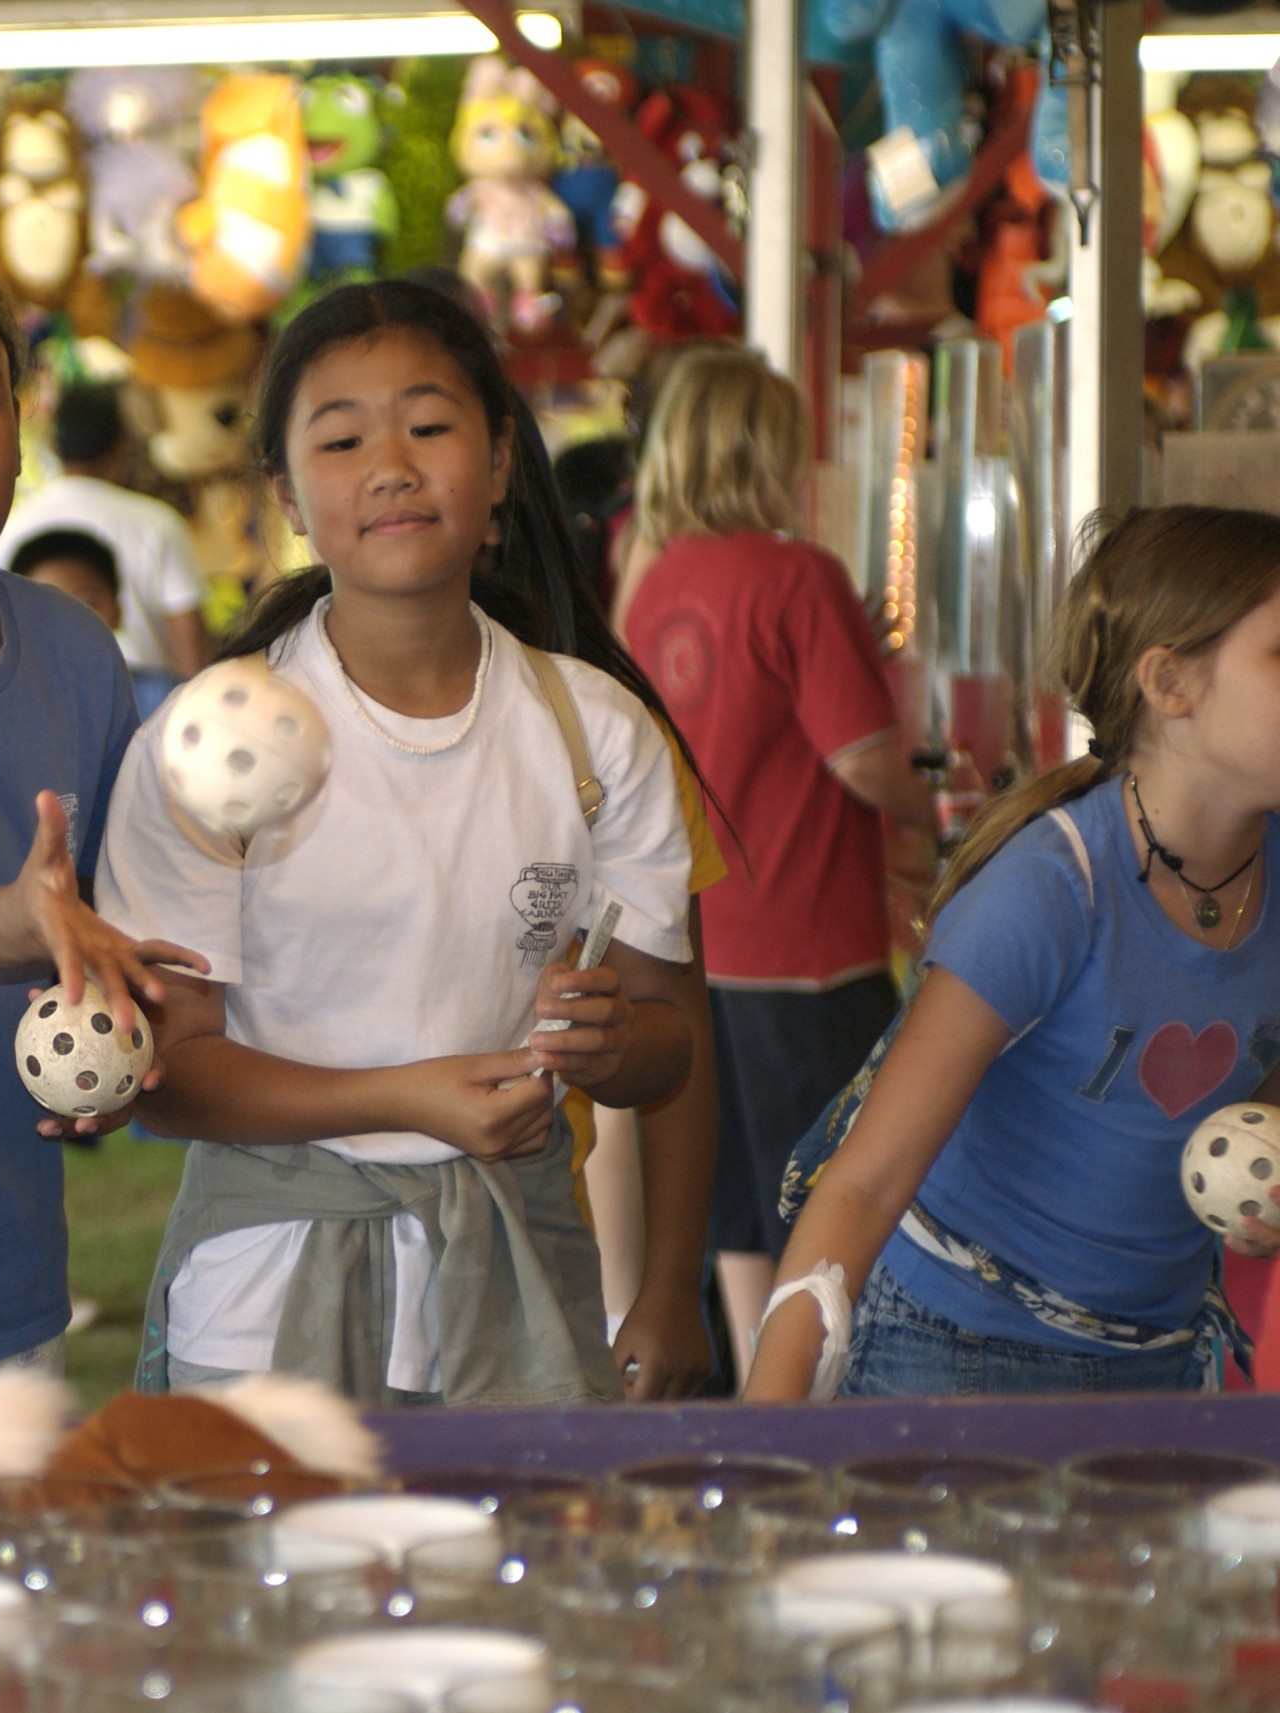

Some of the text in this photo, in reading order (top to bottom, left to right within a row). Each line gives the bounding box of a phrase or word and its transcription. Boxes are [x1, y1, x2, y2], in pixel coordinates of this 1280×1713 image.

[540, 883, 562, 891] OUR
[528, 890, 569, 900] BIG FAT
[530, 900, 562, 910] GREEK
[520, 909, 566, 918] CARNIVA
